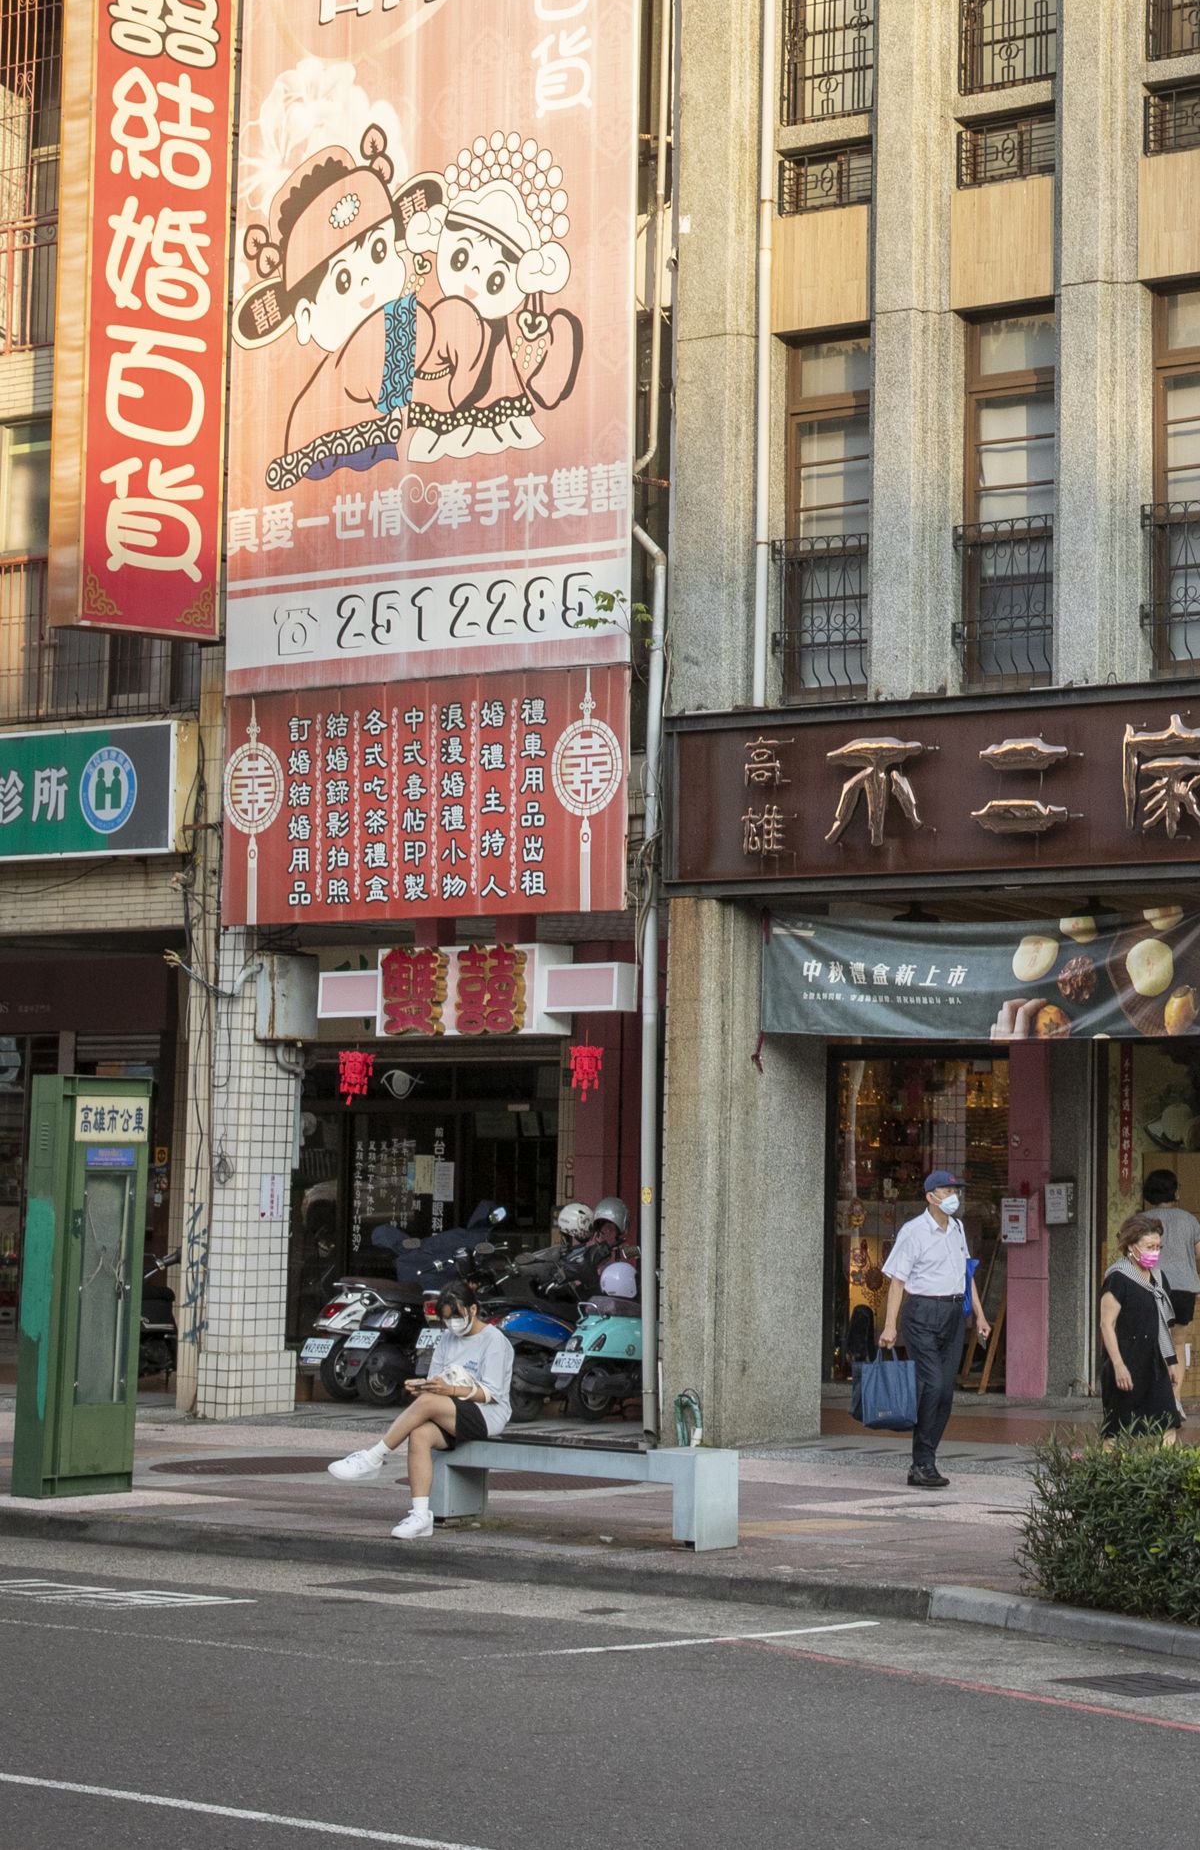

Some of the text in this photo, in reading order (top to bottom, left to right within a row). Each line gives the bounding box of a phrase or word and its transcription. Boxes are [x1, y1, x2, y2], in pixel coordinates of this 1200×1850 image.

[335, 571, 598, 650] 2512285
[288, 716, 313, 906] 訂婚結婚用品
[325, 710, 351, 905] 結婚錄影拍照
[362, 708, 390, 904] 各式吃茶禮盒
[401, 705, 429, 902] 中式喜帖印製
[440, 702, 468, 901] 浪漫婚禮小物
[480, 699, 508, 899] 婚禮主持人
[519, 696, 547, 897] 禮車用品出租
[741, 735, 794, 856] 高雄
[802, 959, 969, 988] 中秋禮盒新上市
[80, 1104, 145, 1134] 高雄市公車
